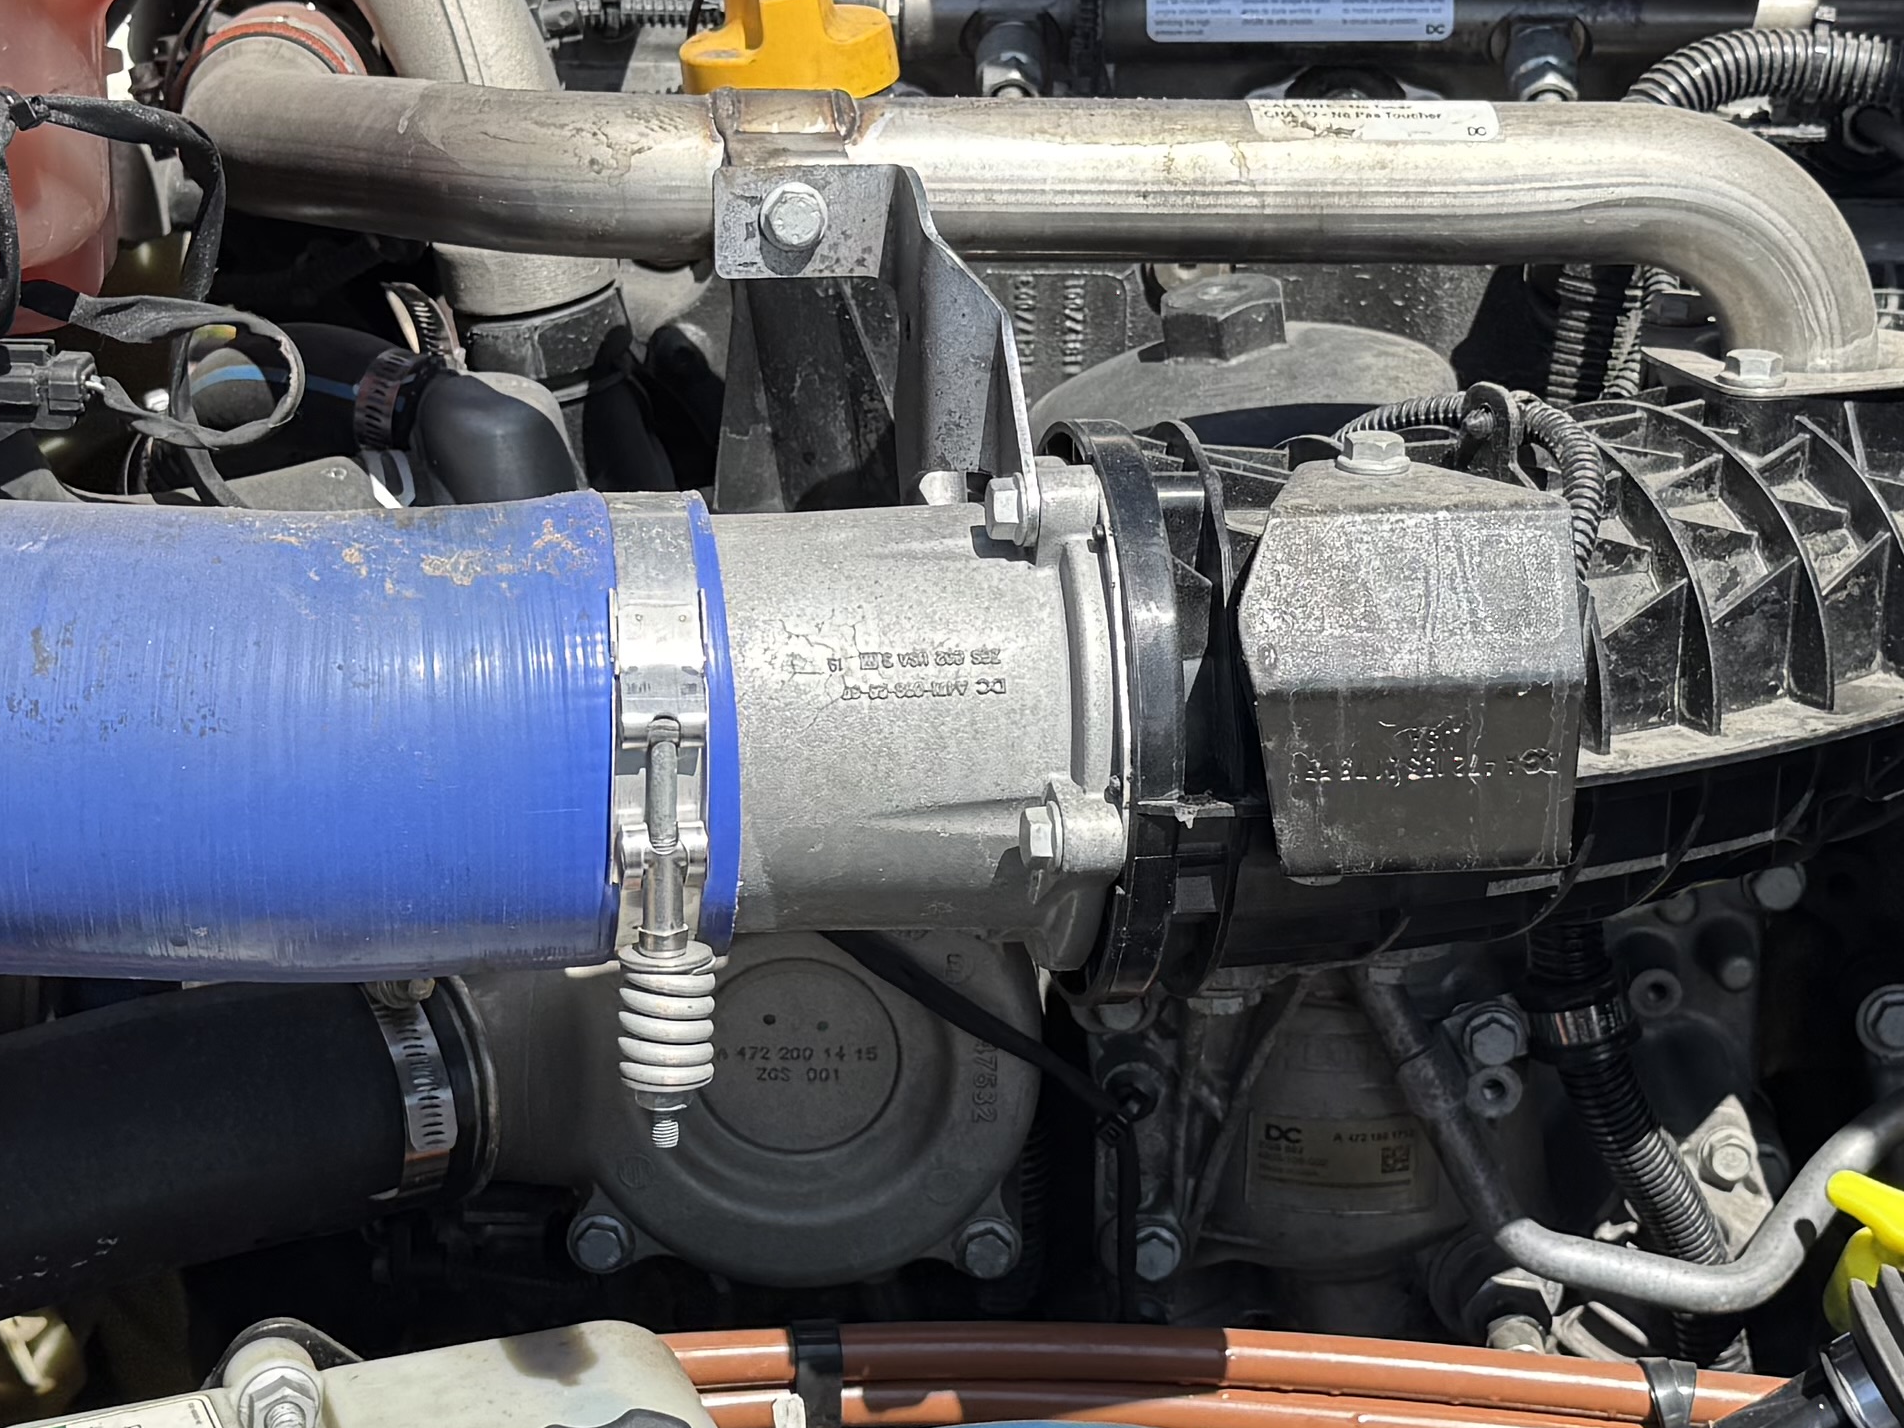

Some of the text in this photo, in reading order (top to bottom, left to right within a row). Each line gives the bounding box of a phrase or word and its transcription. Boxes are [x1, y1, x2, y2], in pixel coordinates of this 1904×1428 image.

[1426, 24, 1445, 35] DC
[1387, 110, 1442, 120] Toucher
[1467, 126, 1486, 136] DC
[975, 678, 1006, 695] DC
[736, 1047, 770, 1061] 472
[778, 1047, 814, 1061] 200
[824, 1045, 845, 1061] 14
[856, 1047, 878, 1062] 15
[806, 1068, 840, 1082] 001
[1265, 1123, 1302, 1144] DC
